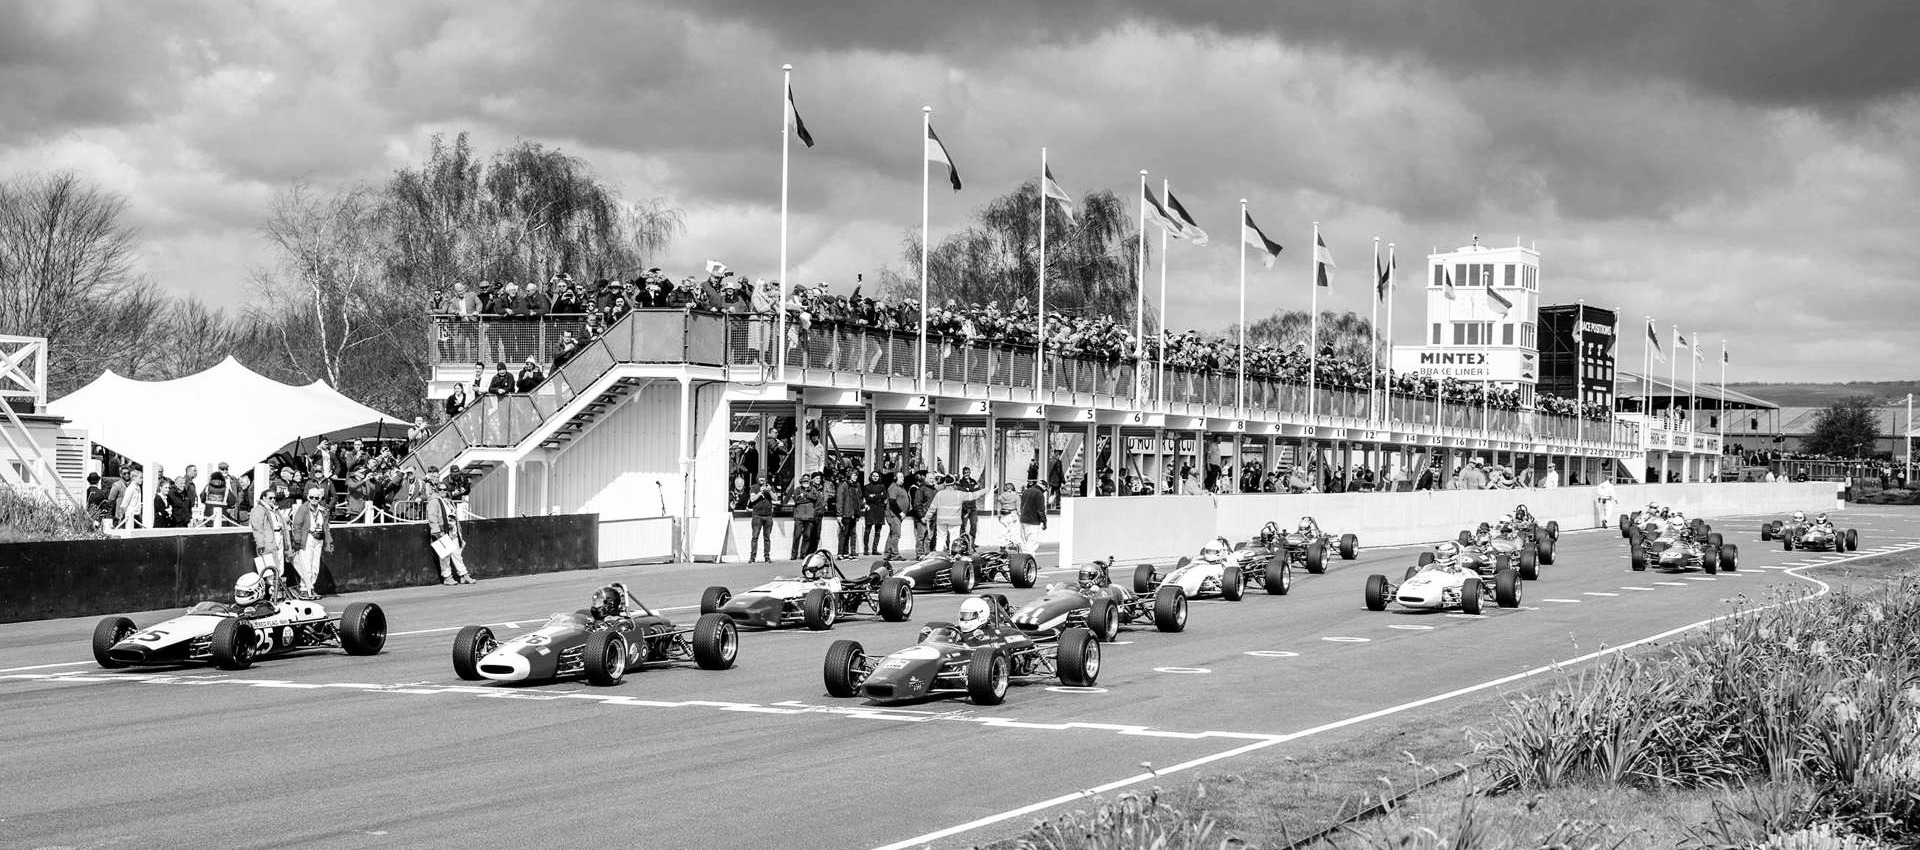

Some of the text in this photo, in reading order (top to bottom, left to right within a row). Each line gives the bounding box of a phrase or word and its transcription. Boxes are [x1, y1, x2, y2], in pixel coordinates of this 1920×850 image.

[1591, 322, 1612, 336] POSITIONS
[1420, 352, 1489, 365] MINTEX
[1420, 367, 1452, 375] BRAKE
[919, 396, 926, 407] 2
[980, 401, 987, 412] 3
[1036, 405, 1043, 416] 4
[1087, 409, 1093, 419] 5
[1134, 412, 1141, 423] 6
[1198, 417, 1204, 427] 7
[1237, 420, 1244, 430] 8
[1274, 423, 1281, 432] 9
[1303, 427, 1314, 435] 10
[1337, 429, 1346, 437] 11
[1365, 431, 1375, 439] 12
[1406, 434, 1416, 442] 14
[1432, 436, 1441, 444] 15
[1137, 438, 1166, 450] MOTR
[255, 627, 273, 655] 25
